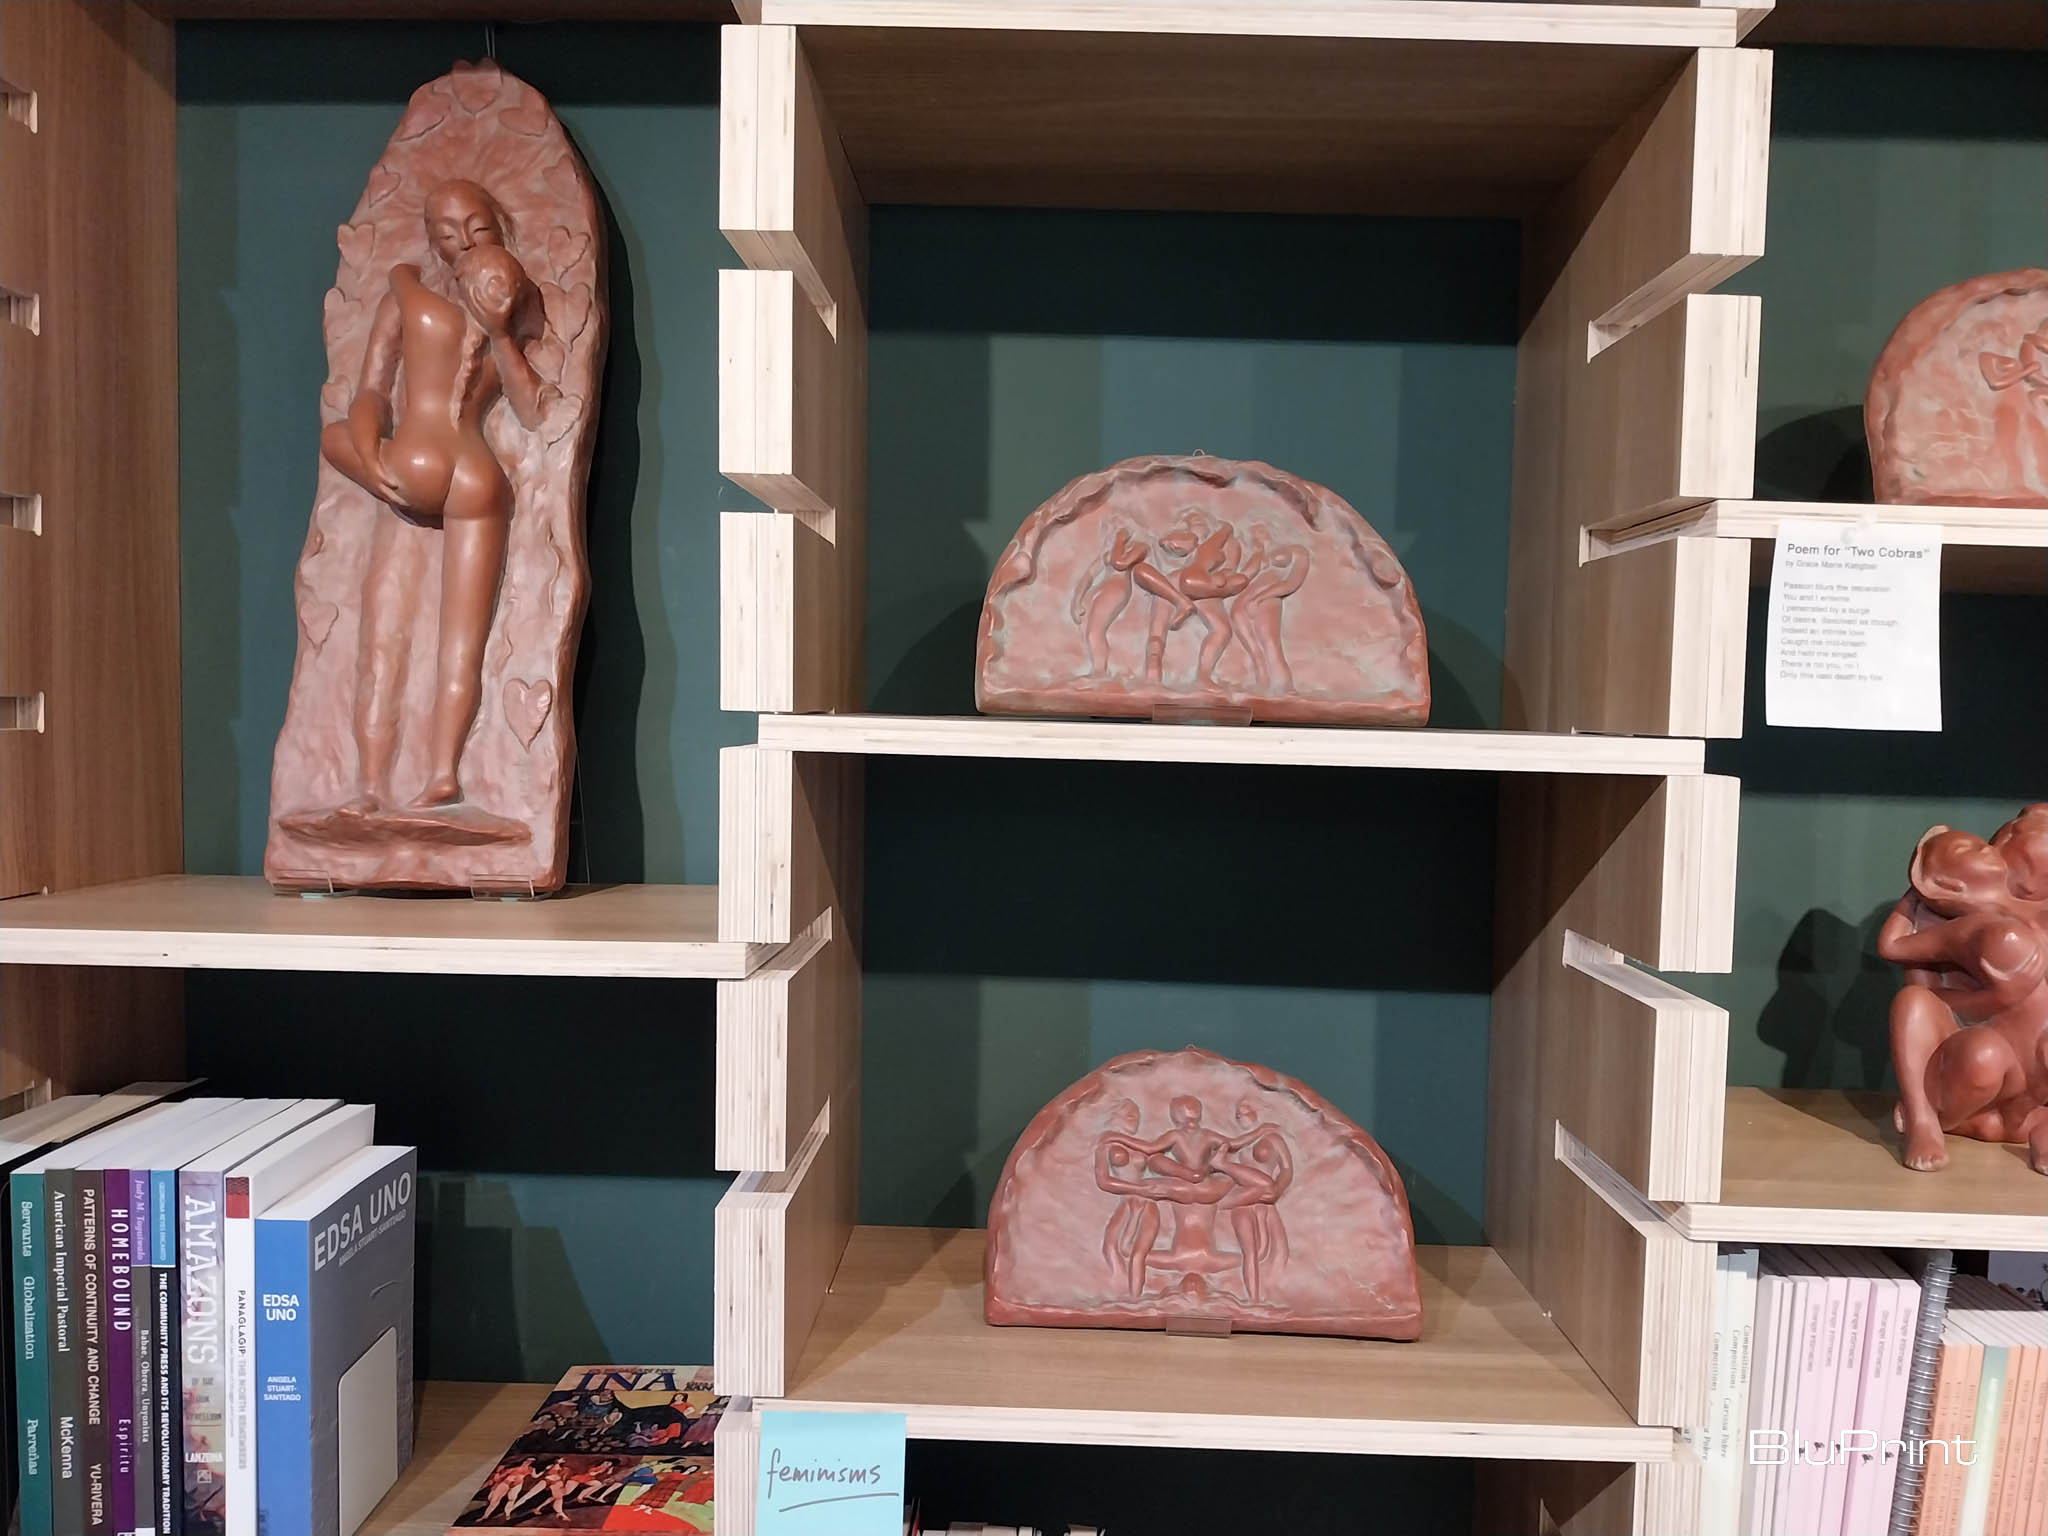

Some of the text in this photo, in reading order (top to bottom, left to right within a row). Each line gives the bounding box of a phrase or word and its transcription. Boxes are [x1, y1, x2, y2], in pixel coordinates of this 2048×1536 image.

[1787, 543, 1930, 559] Poem for "Two Cobras"
[134, 1179, 145, 1200] Judy
[315, 1172, 411, 1272] EDSA UNO
[21, 1201, 37, 1360] Servants Globalization
[52, 1190, 71, 1352] American Imperial Pastoral
[111, 1209, 131, 1331] HOMEBOUND
[185, 1195, 218, 1364] AMAZONS
[83, 1189, 101, 1425] PATTERNS OF CONTINUITY AND CHANGE
[263, 1294, 300, 1307] EDSA
[266, 1308, 297, 1321] UNO
[267, 1376, 297, 1384] ANGELA
[574, 1372, 677, 1391] INA
[1711, 1331, 1723, 1391] Compositions
[1730, 1330, 1741, 1389] Compositions
[1740, 1325, 1752, 1383] Compositions
[140, 1329, 151, 1443] Babae, Obrera, Unyonista
[159, 1272, 171, 1534] THE COMMUNITY PRESS AND ITS REVOLUTIONARY TRADITION
[263, 1394, 302, 1402] SANTIAGO
[267, 1385, 297, 1393] STUART-
[27, 1418, 40, 1476] Parreñas
[60, 1416, 74, 1479] McKenna
[116, 1418, 132, 1473] Espiritu
[767, 1448, 881, 1499] feminisms
[90, 1463, 103, 1526] YU-RIVERA
